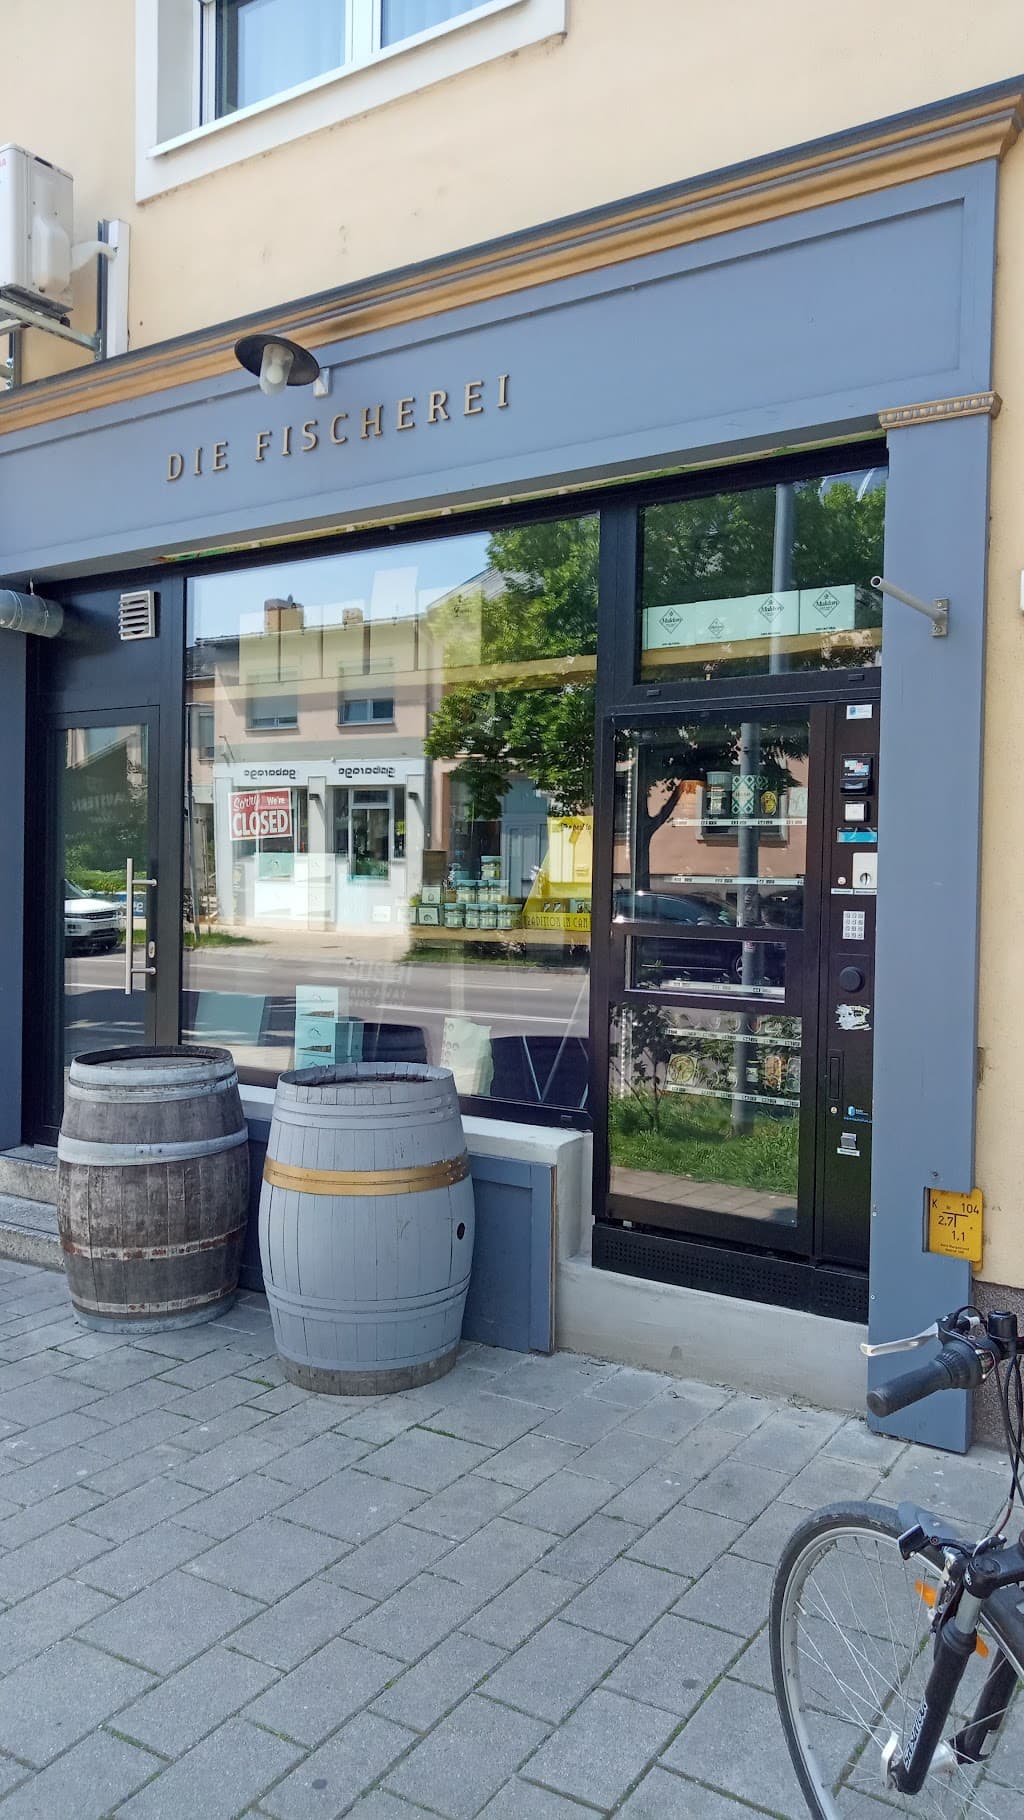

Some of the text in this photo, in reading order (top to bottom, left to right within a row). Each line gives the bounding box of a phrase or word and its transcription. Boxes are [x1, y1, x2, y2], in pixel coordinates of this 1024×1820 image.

[166, 374, 511, 481] DIE FISCHEREI
[233, 795, 258, 811] Sorry
[233, 810, 289, 836] CLOSED
[931, 1199, 979, 1214] K 104
